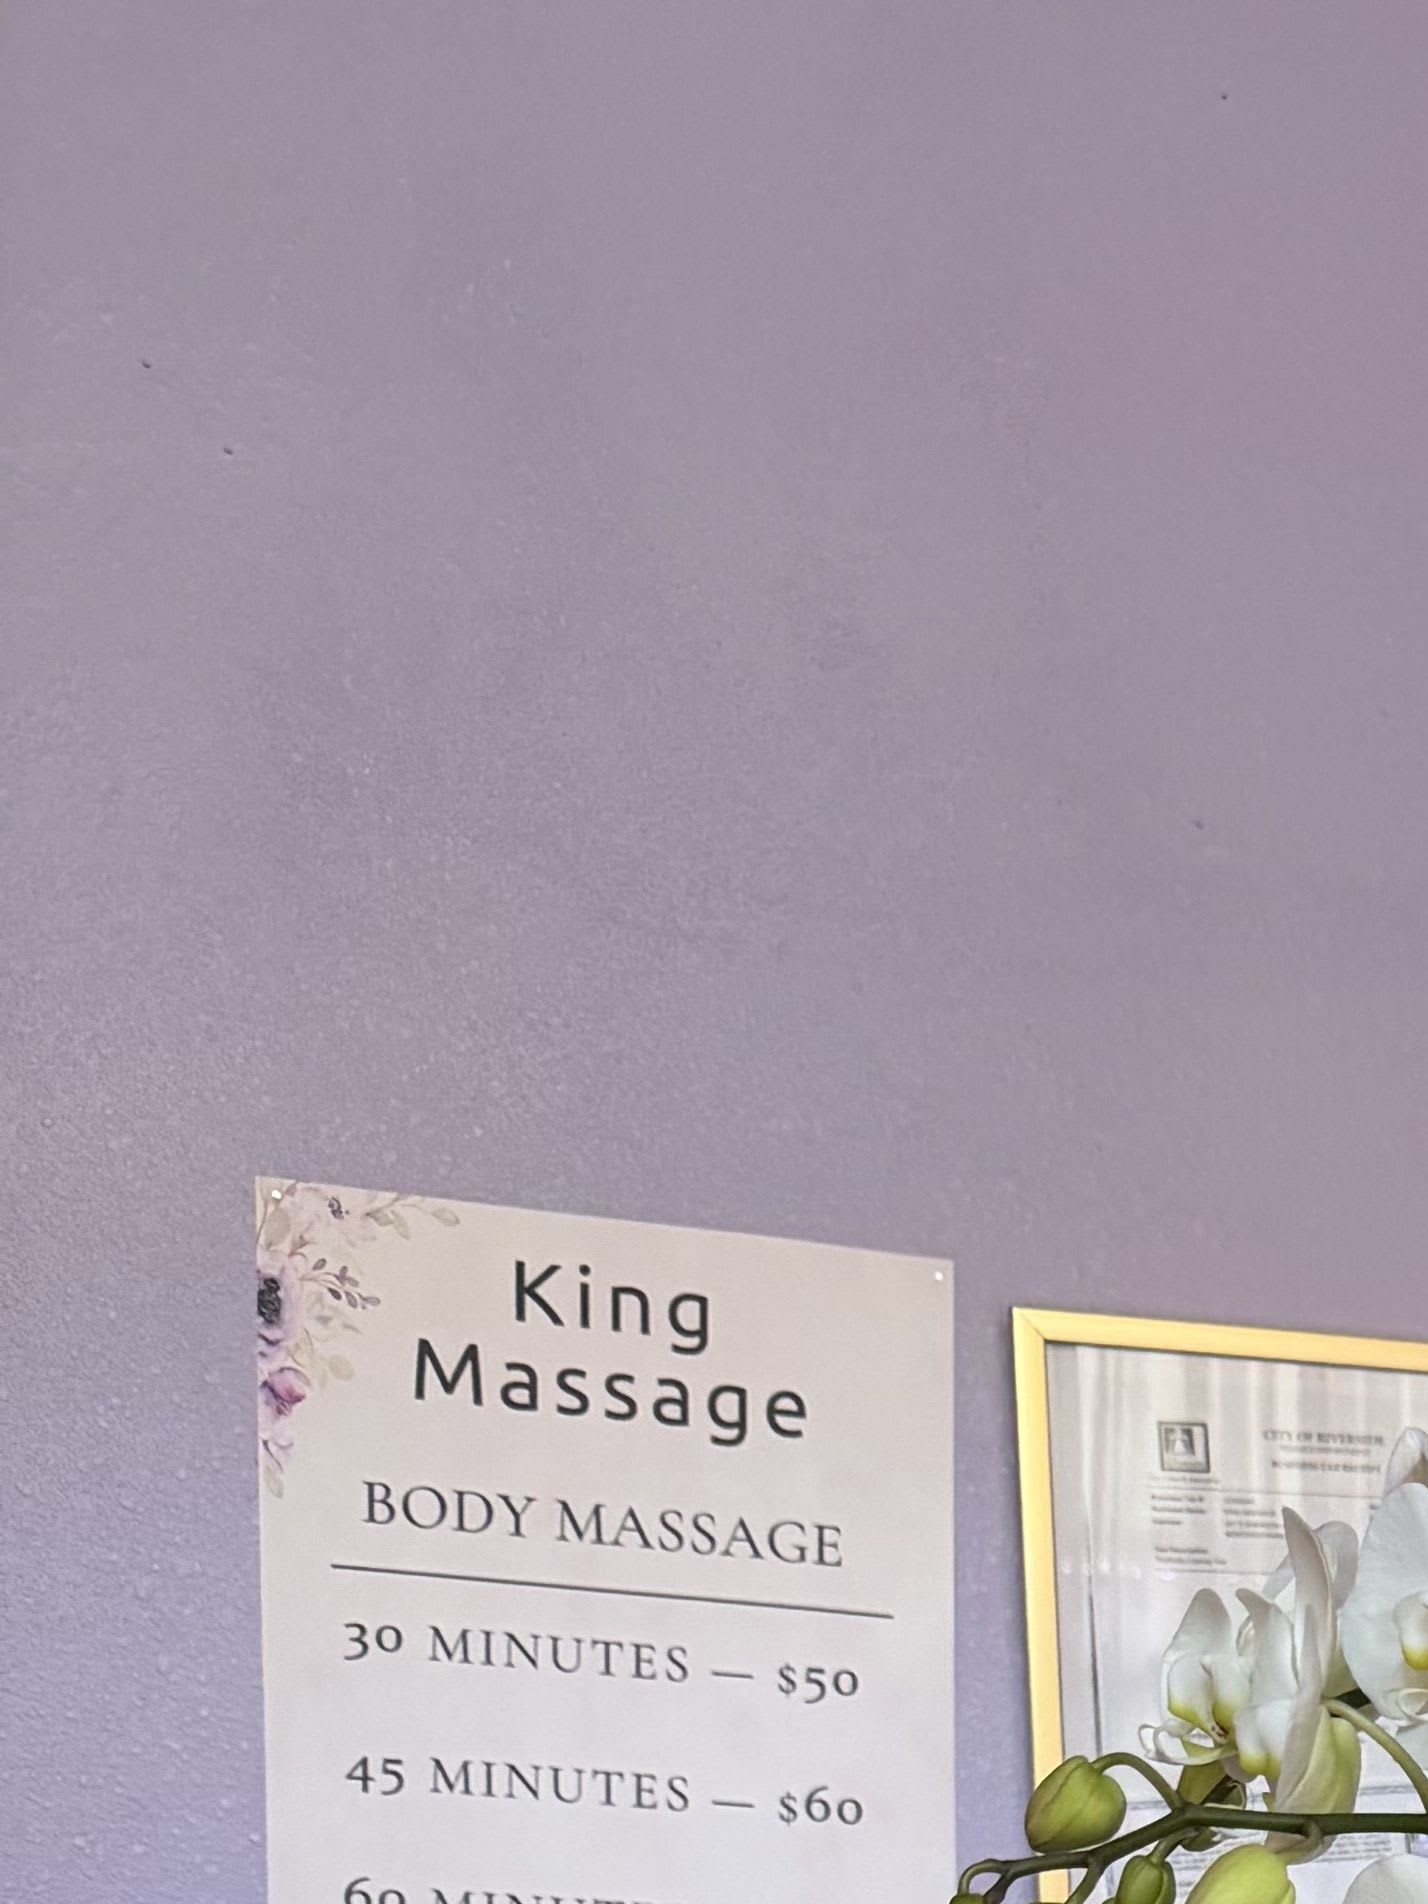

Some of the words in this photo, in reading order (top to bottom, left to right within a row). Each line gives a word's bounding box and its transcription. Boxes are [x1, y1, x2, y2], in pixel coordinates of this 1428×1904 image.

[514, 1260, 709, 1356] King
[414, 1337, 807, 1447] Massage
[362, 1480, 537, 1538] BODY
[556, 1498, 842, 1567] MASSAGE
[343, 1622, 403, 1661] 30
[428, 1625, 689, 1683] MINUTES
[777, 1663, 859, 1705] $50
[345, 1756, 405, 1796] 45
[430, 1756, 689, 1812] MINUTES
[778, 1785, 864, 1826] $60
